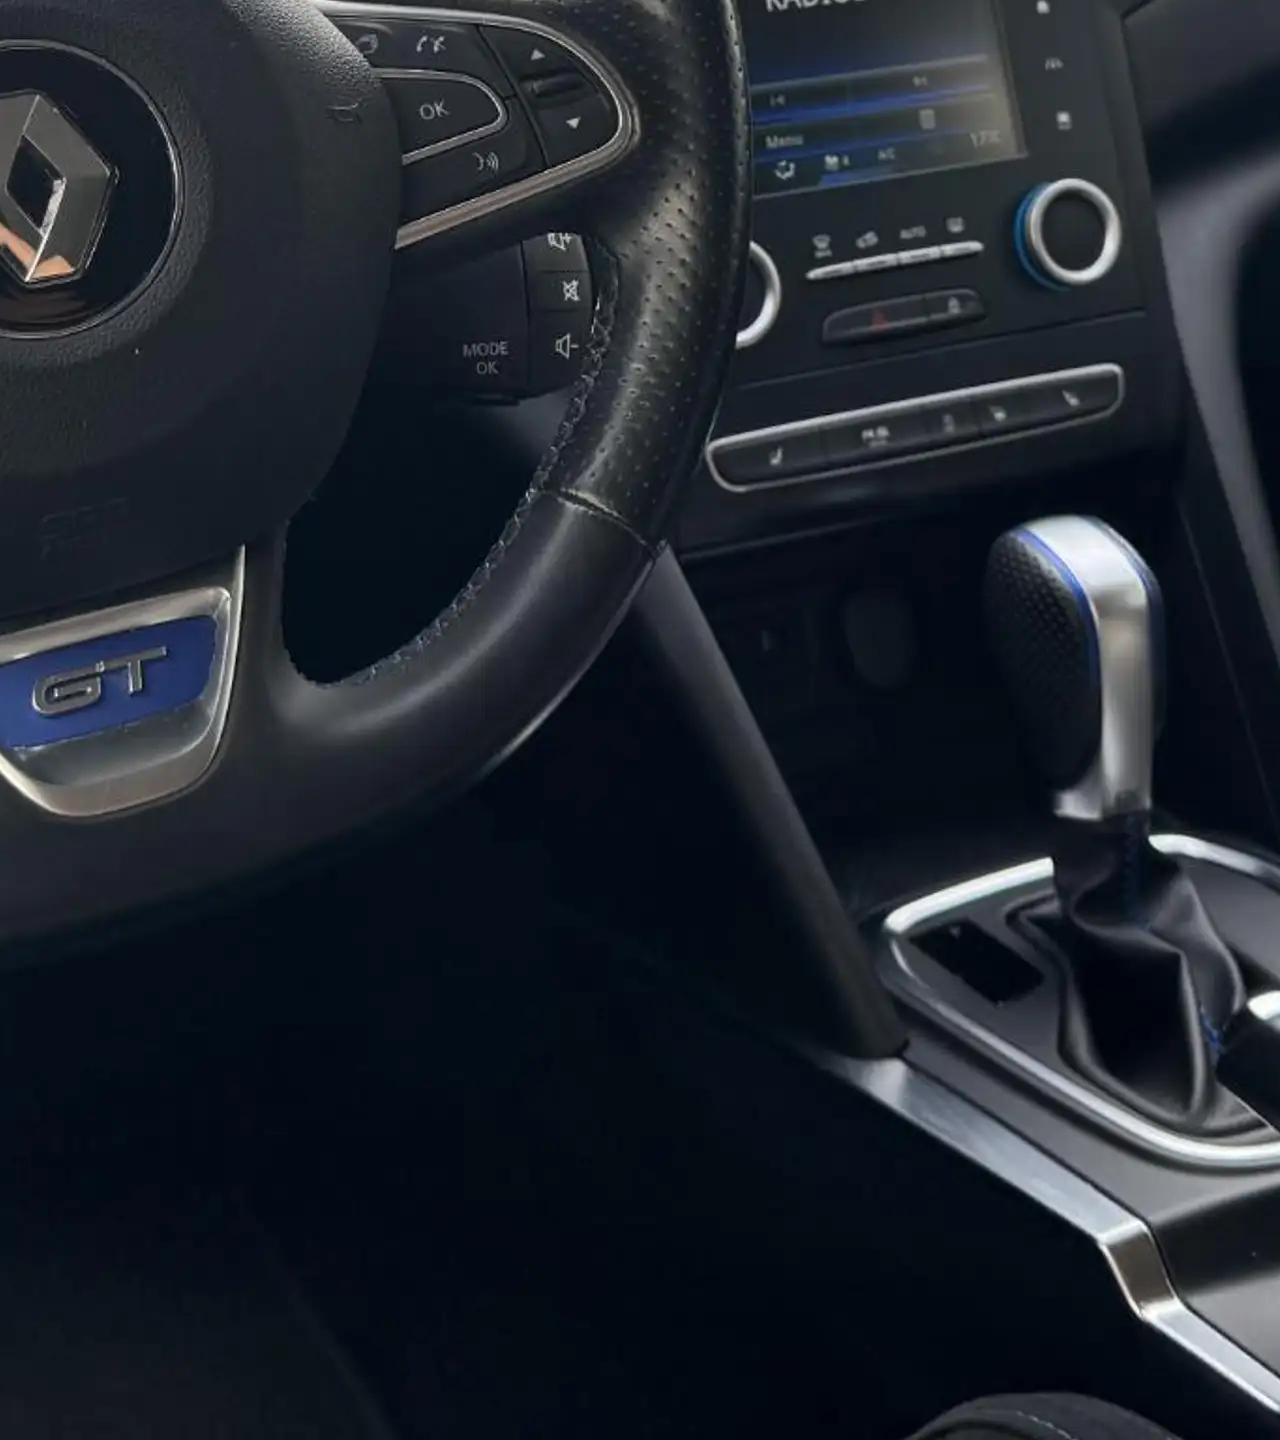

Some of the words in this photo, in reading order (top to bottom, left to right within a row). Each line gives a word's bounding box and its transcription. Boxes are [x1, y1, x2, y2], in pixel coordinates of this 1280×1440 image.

[419, 99, 450, 121] OK
[462, 340, 510, 358] MODE
[475, 360, 500, 376] OK
[31, 645, 168, 718] GT
